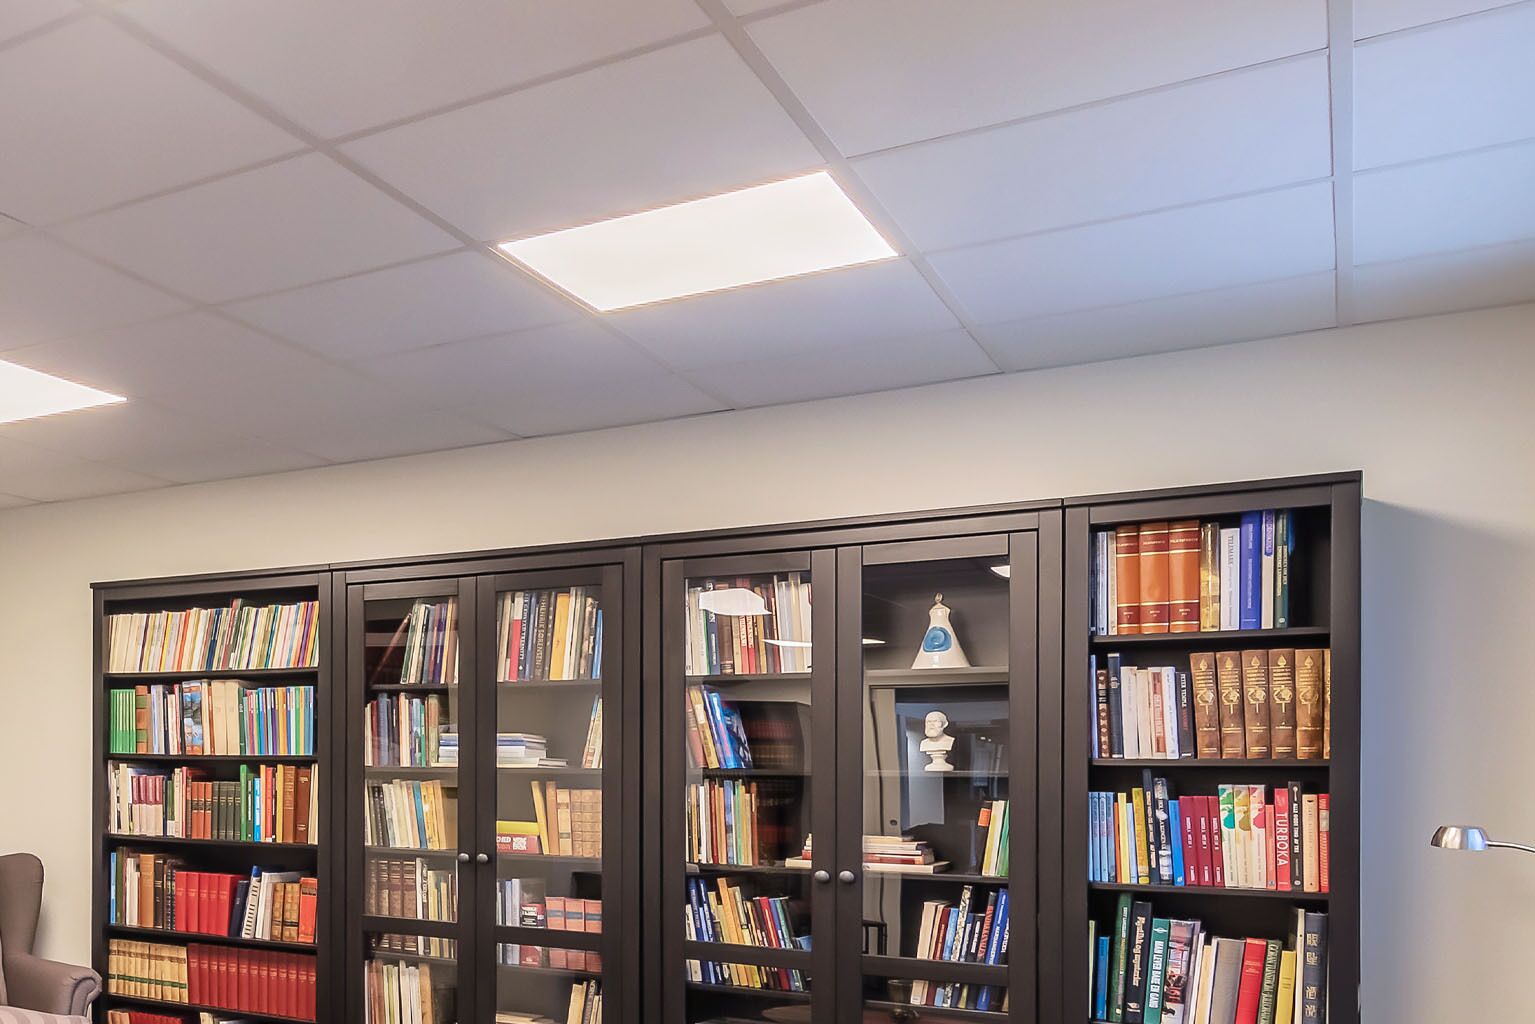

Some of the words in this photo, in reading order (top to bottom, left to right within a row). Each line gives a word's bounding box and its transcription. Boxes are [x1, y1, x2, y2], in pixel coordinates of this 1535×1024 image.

[1276, 812, 1288, 865] TURBOKA
[1154, 940, 1164, 952] MAN
[1152, 953, 1163, 970] LEVER
[1151, 970, 1161, 984] BARE
[1149, 992, 1159, 1008] GANG
